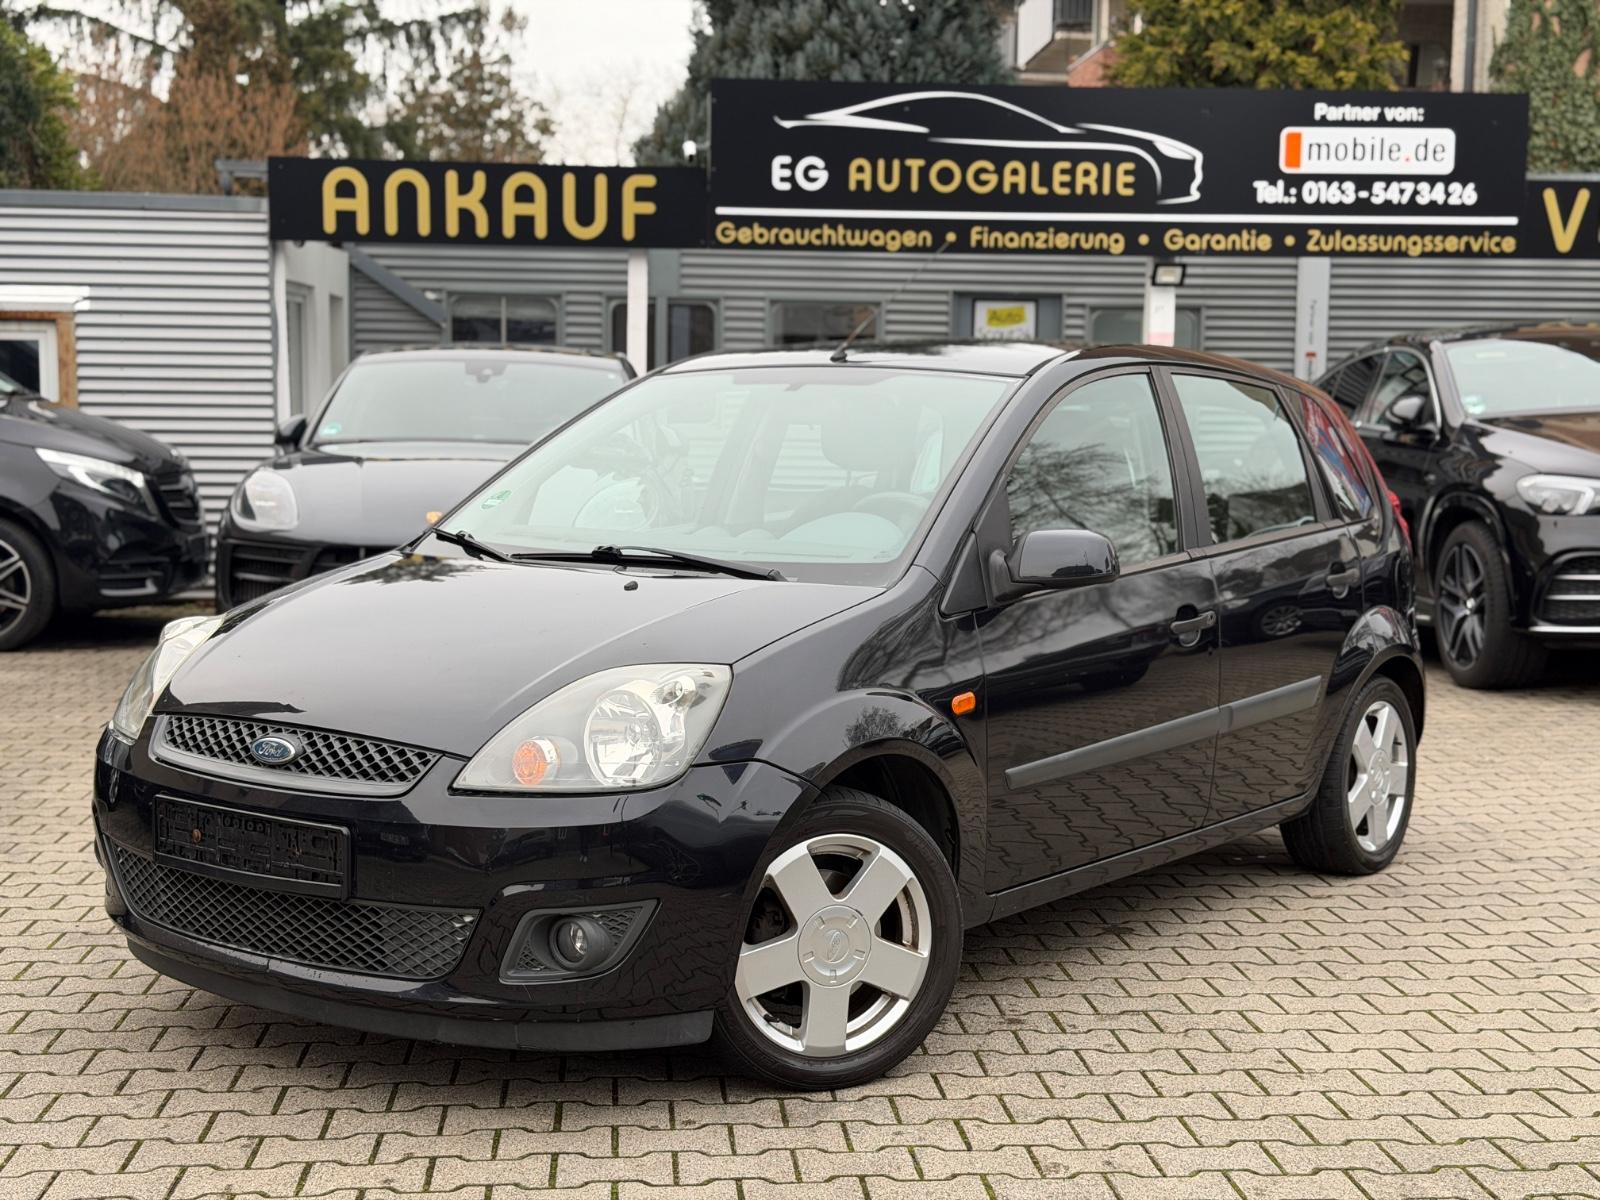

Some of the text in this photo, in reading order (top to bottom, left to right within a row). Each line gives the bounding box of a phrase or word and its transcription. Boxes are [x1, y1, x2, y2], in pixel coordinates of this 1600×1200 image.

[1313, 101, 1425, 122] Partner von:
[1308, 137, 1446, 162] mobile.de
[771, 154, 1136, 197] EG AUTOGALERIE
[322, 166, 657, 242] ANKAUF
[1252, 179, 1479, 206] Tel.: 0163-5473426
[1542, 187, 1600, 253] V
[715, 221, 1518, 257] Gebrauchtwagen Finanzierung Garantie Zulassungsservice
[258, 741, 284, 757] Ford
